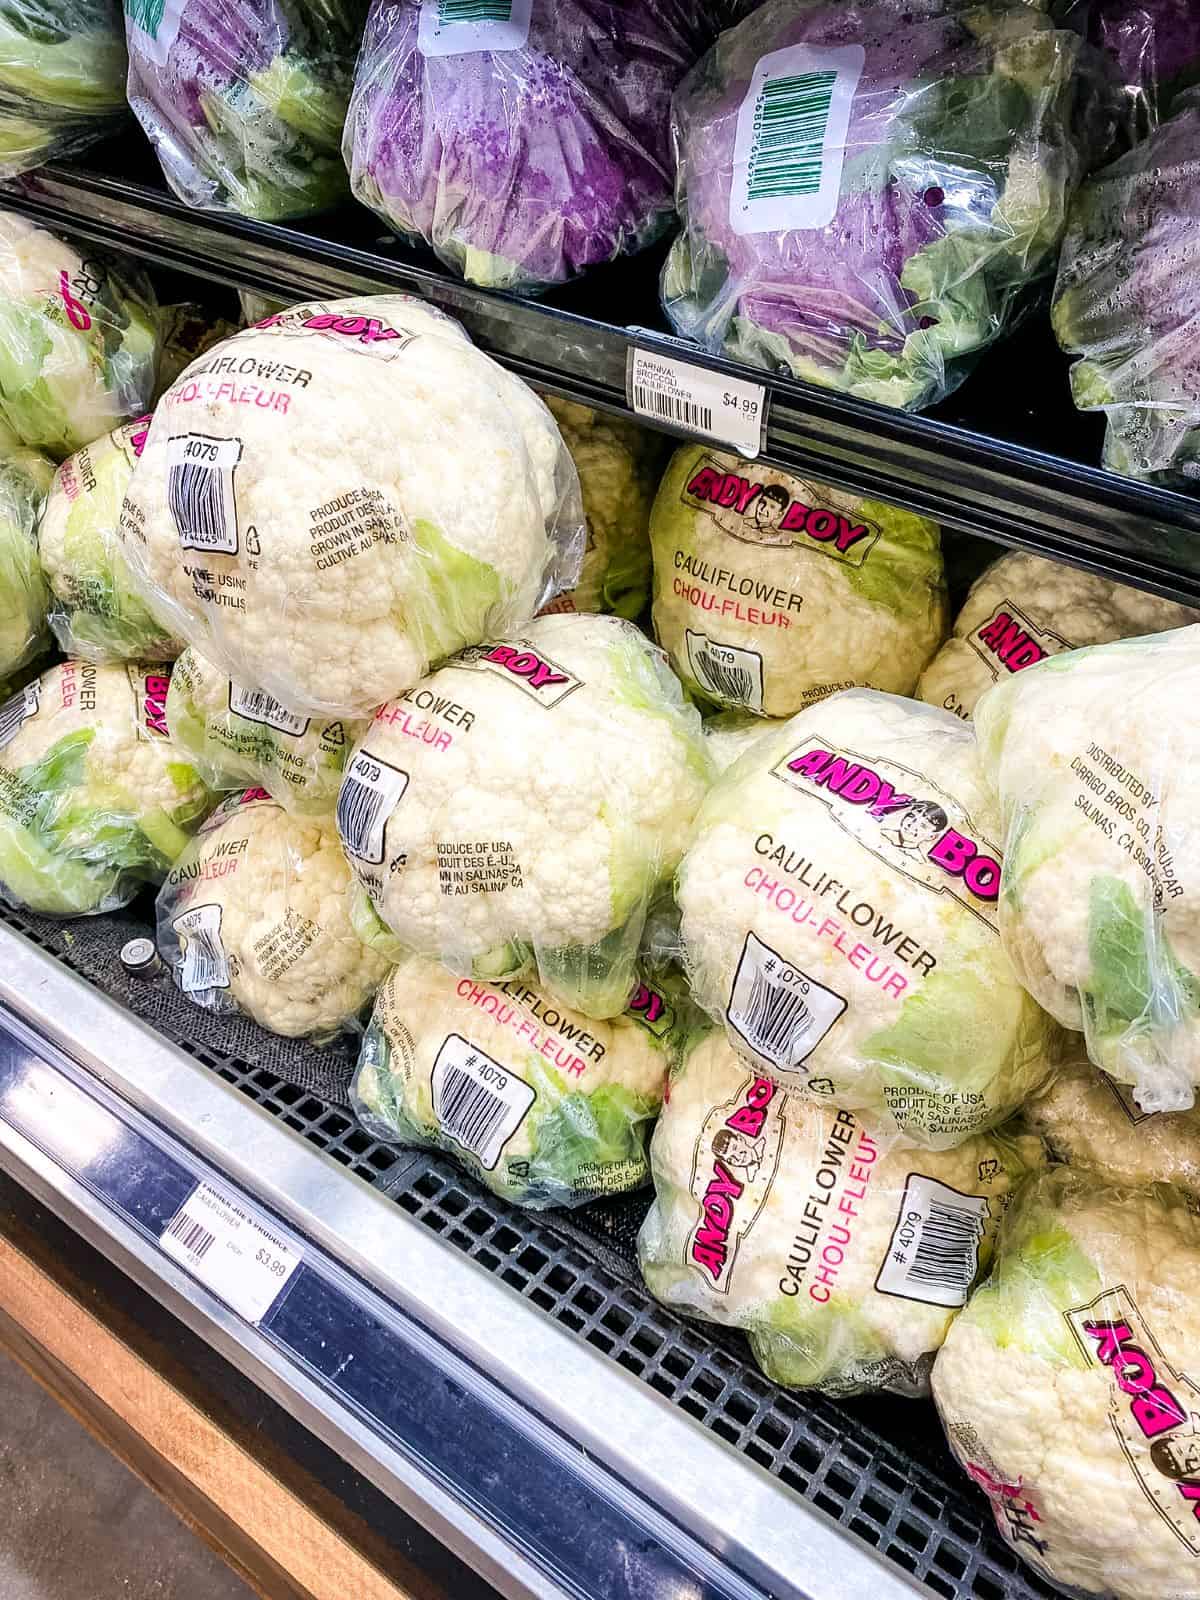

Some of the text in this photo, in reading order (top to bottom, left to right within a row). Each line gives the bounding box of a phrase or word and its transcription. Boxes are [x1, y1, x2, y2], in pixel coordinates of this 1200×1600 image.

[303, 313, 403, 345] BOY
[636, 367, 678, 388] BROCCOLI
[722, 392, 759, 415] $4.99
[183, 440, 220, 462] 4079
[309, 489, 362, 522] PRODUCE
[687, 466, 869, 554] ANDY BOY
[309, 510, 356, 540] PRODUIT
[310, 529, 352, 556] GROWN
[351, 523, 365, 538] IN
[316, 542, 360, 570] CULTIVÉ
[360, 536, 373, 553] AU
[673, 550, 805, 613] CAULIFLOWER
[673, 578, 793, 630] CHOU-FLEUR
[978, 611, 1051, 674] AND
[484, 645, 570, 691] BOY
[144, 675, 170, 737] BOY
[355, 758, 382, 783] 4079
[1086, 742, 1161, 810] DISTRIBUTED BY
[1074, 794, 1118, 840] SALINAS,
[1117, 833, 1136, 855] CA
[1104, 790, 1138, 825] BROS.
[787, 749, 1002, 902] ANDY BO
[475, 841, 489, 854] OF
[491, 841, 513, 853] USA
[453, 870, 464, 882] IN
[454, 884, 469, 896] AU
[511, 875, 524, 889] CA
[754, 833, 938, 979] CAULIFLOWER
[743, 867, 910, 1001] CHOU-FLEUR
[456, 978, 588, 1080] CHOU-FLEUR
[477, 1063, 509, 1092] 4079
[927, 1099, 951, 1115] DES
[943, 1093, 959, 1105] OF
[961, 1091, 985, 1105] USA
[692, 1159, 746, 1281] ANDY
[725, 1076, 779, 1139] BO
[779, 1109, 857, 1298] CAULIFLOWER
[900, 1211, 923, 1249] 4079
[255, 1248, 286, 1278] $3.99
[1082, 1320, 1188, 1439] BOY
